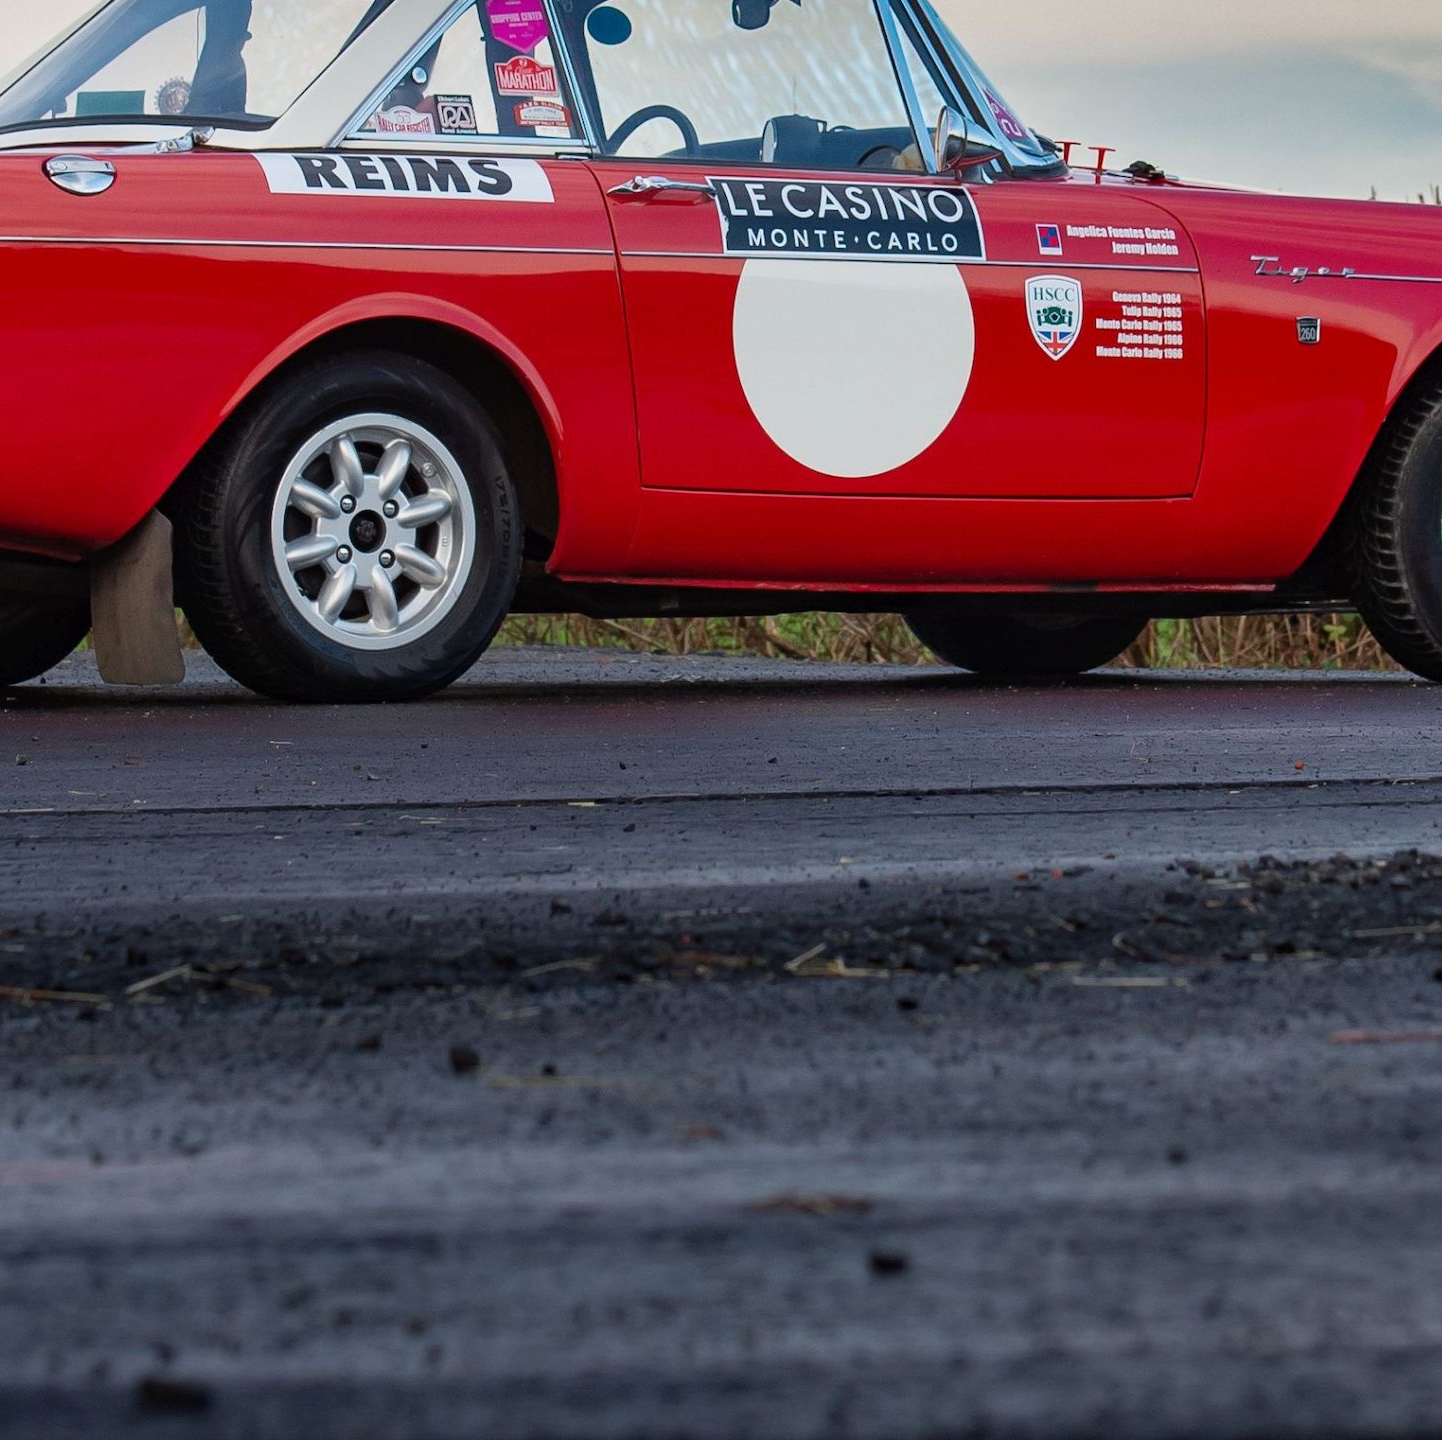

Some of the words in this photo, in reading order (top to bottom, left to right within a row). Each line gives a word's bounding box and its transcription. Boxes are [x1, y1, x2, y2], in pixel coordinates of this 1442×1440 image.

[497, 66, 554, 90] MARATHON
[292, 155, 513, 196] REIMS
[720, 182, 774, 217] LE
[780, 184, 964, 223] CASINO
[1066, 224, 1107, 238] Angelica
[1108, 226, 1145, 239] Fuentes
[1145, 227, 1176, 240] Garcia
[747, 228, 847, 249] MONTE
[866, 231, 958, 252] CARLO
[1112, 241, 1145, 255] Jeremy
[1145, 243, 1179, 255] Holden
[1250, 255, 1356, 283] Tiger
[1033, 287, 1075, 301] HSCC
[1142, 292, 1161, 304] Rally
[1142, 306, 1162, 318] Rally
[1096, 318, 1120, 329] Monte
[1121, 319, 1142, 330] Carlo
[1143, 320, 1162, 331] Rally
[1117, 332, 1142, 344] Alpine
[1143, 333, 1163, 345] Rally
[1300, 327, 1316, 340] 260
[1096, 346, 1121, 357] Monte
[1121, 346, 1143, 358] Carlo
[1143, 347, 1163, 359] Rally
